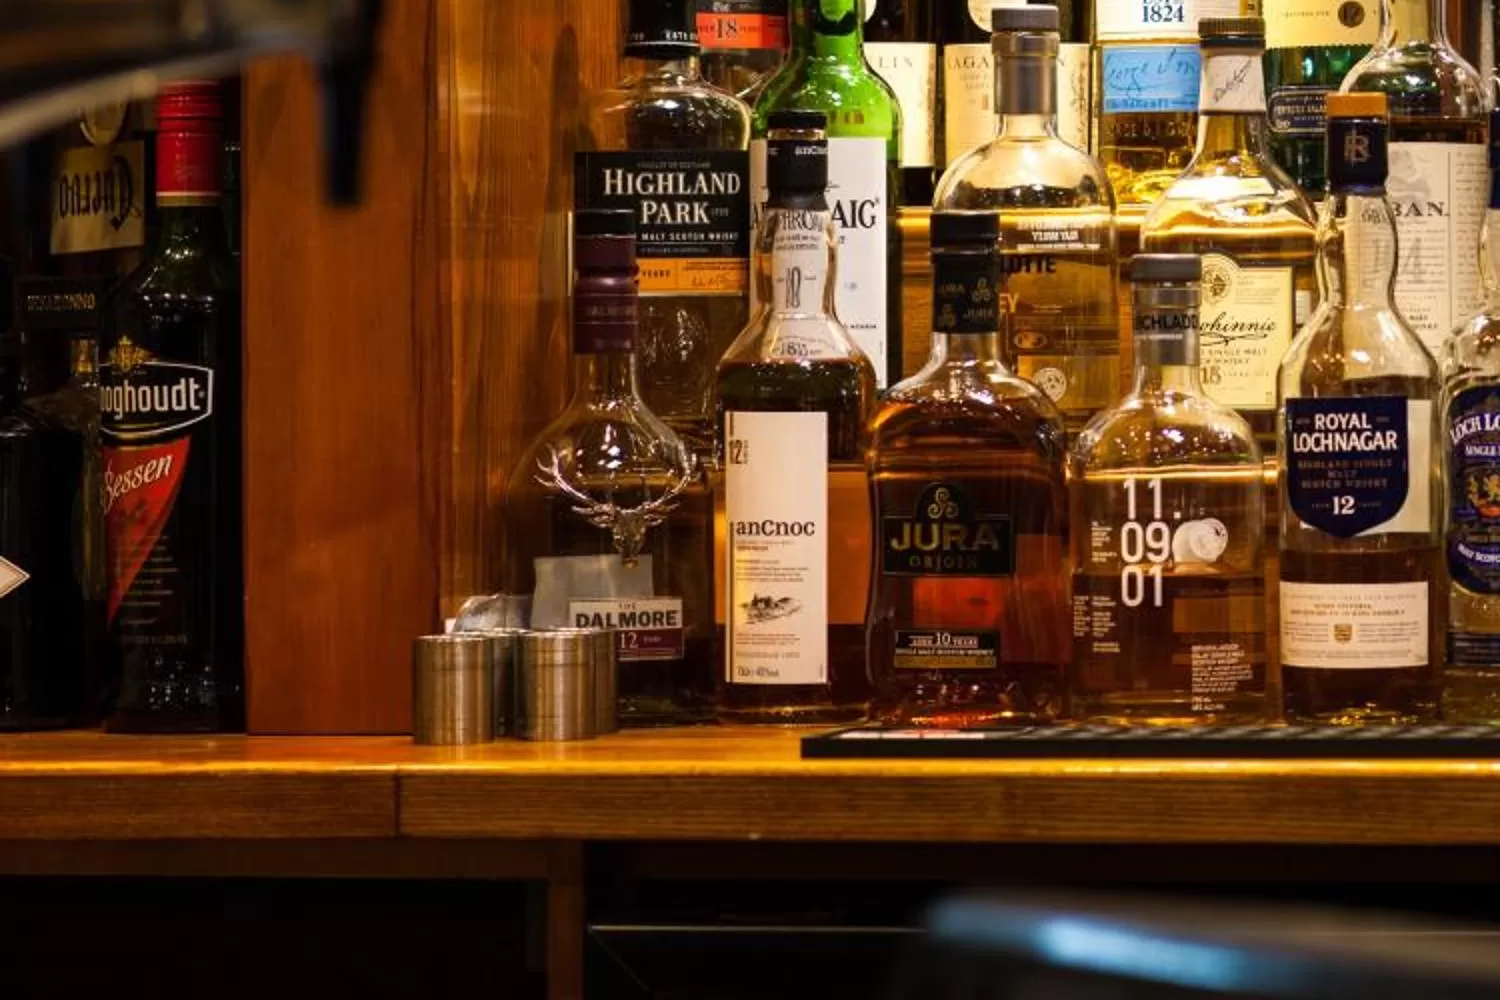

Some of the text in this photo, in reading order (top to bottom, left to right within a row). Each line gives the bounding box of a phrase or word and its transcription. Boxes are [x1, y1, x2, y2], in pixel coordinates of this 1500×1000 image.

[1143, 4, 1185, 23] 1824
[716, 13, 738, 41] 18
[603, 168, 741, 196] HIGHLAND
[640, 200, 711, 225] PARK
[1202, 366, 1223, 385] 15
[1314, 412, 1373, 431] ROYAL
[1450, 414, 1481, 446] LOCH
[729, 439, 744, 466] 12
[1293, 430, 1398, 453] LOCHNAGAR
[1331, 494, 1356, 516] 12
[735, 518, 817, 538] anCnoc
[890, 521, 1000, 551] JURA
[1121, 520, 1171, 563] 09
[1121, 564, 1162, 608] 01
[575, 609, 680, 629] DALMORE
[620, 631, 640, 650] 12
[935, 631, 951, 647] 10
